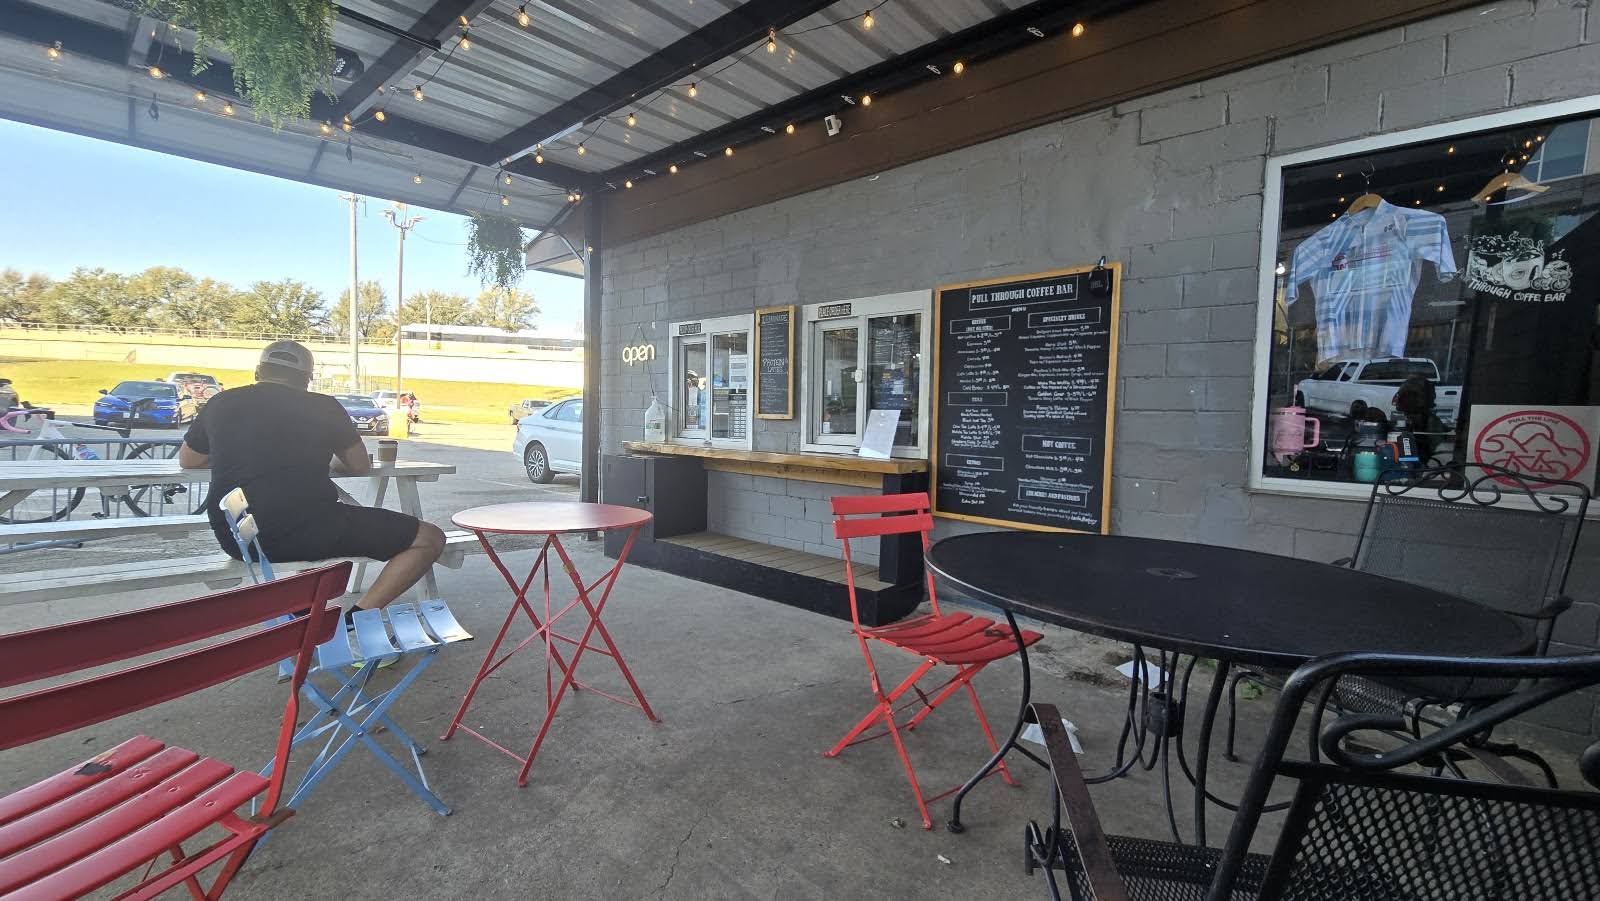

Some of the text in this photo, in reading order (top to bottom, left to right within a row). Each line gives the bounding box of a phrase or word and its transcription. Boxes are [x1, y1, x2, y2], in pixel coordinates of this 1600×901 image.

[972, 284, 1073, 304] PULL THROUGH COFFEE BAR
[1468, 278, 1511, 299] THROUGH
[1544, 292, 1566, 302] BAR
[622, 344, 654, 366] open
